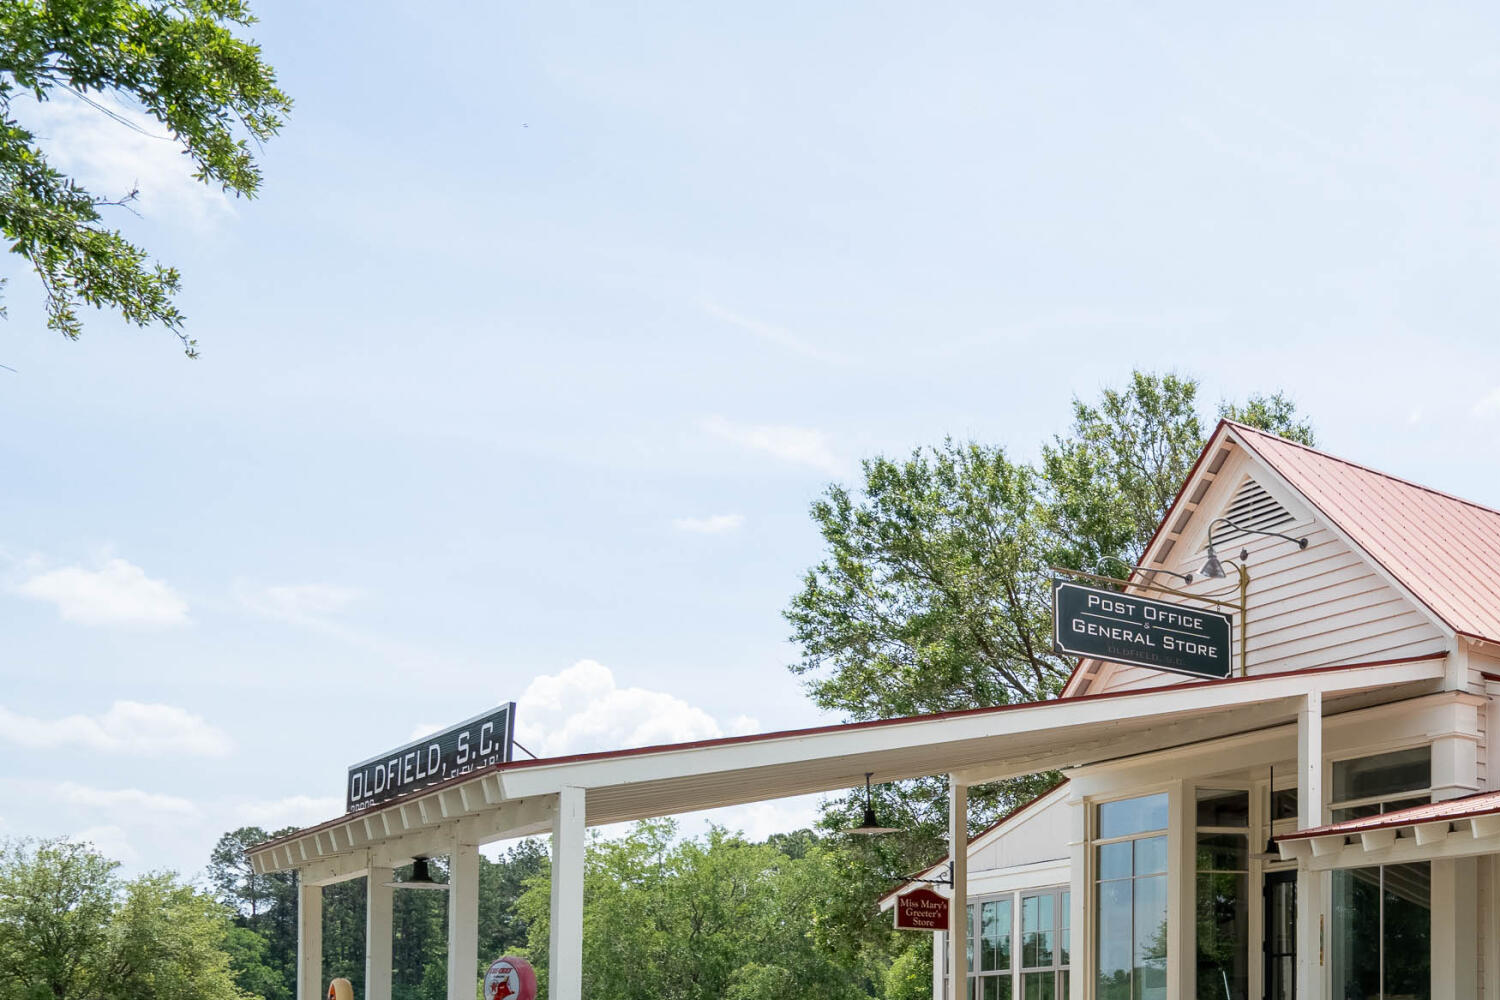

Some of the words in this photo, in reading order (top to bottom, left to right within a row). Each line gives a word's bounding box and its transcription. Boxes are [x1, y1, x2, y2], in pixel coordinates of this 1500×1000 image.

[1088, 594, 1136, 616] POST
[1144, 606, 1204, 630] OFFICE
[1143, 622, 1151, 630] &
[1072, 618, 1156, 647] GENERAL
[1163, 635, 1218, 659] STORE
[351, 744, 446, 801] OLDFIELD,
[456, 721, 499, 765] S.C.
[899, 898, 919, 908] Miss
[920, 899, 947, 912] Mary's
[905, 908, 942, 918] Greeter's
[912, 917, 935, 927] Store
